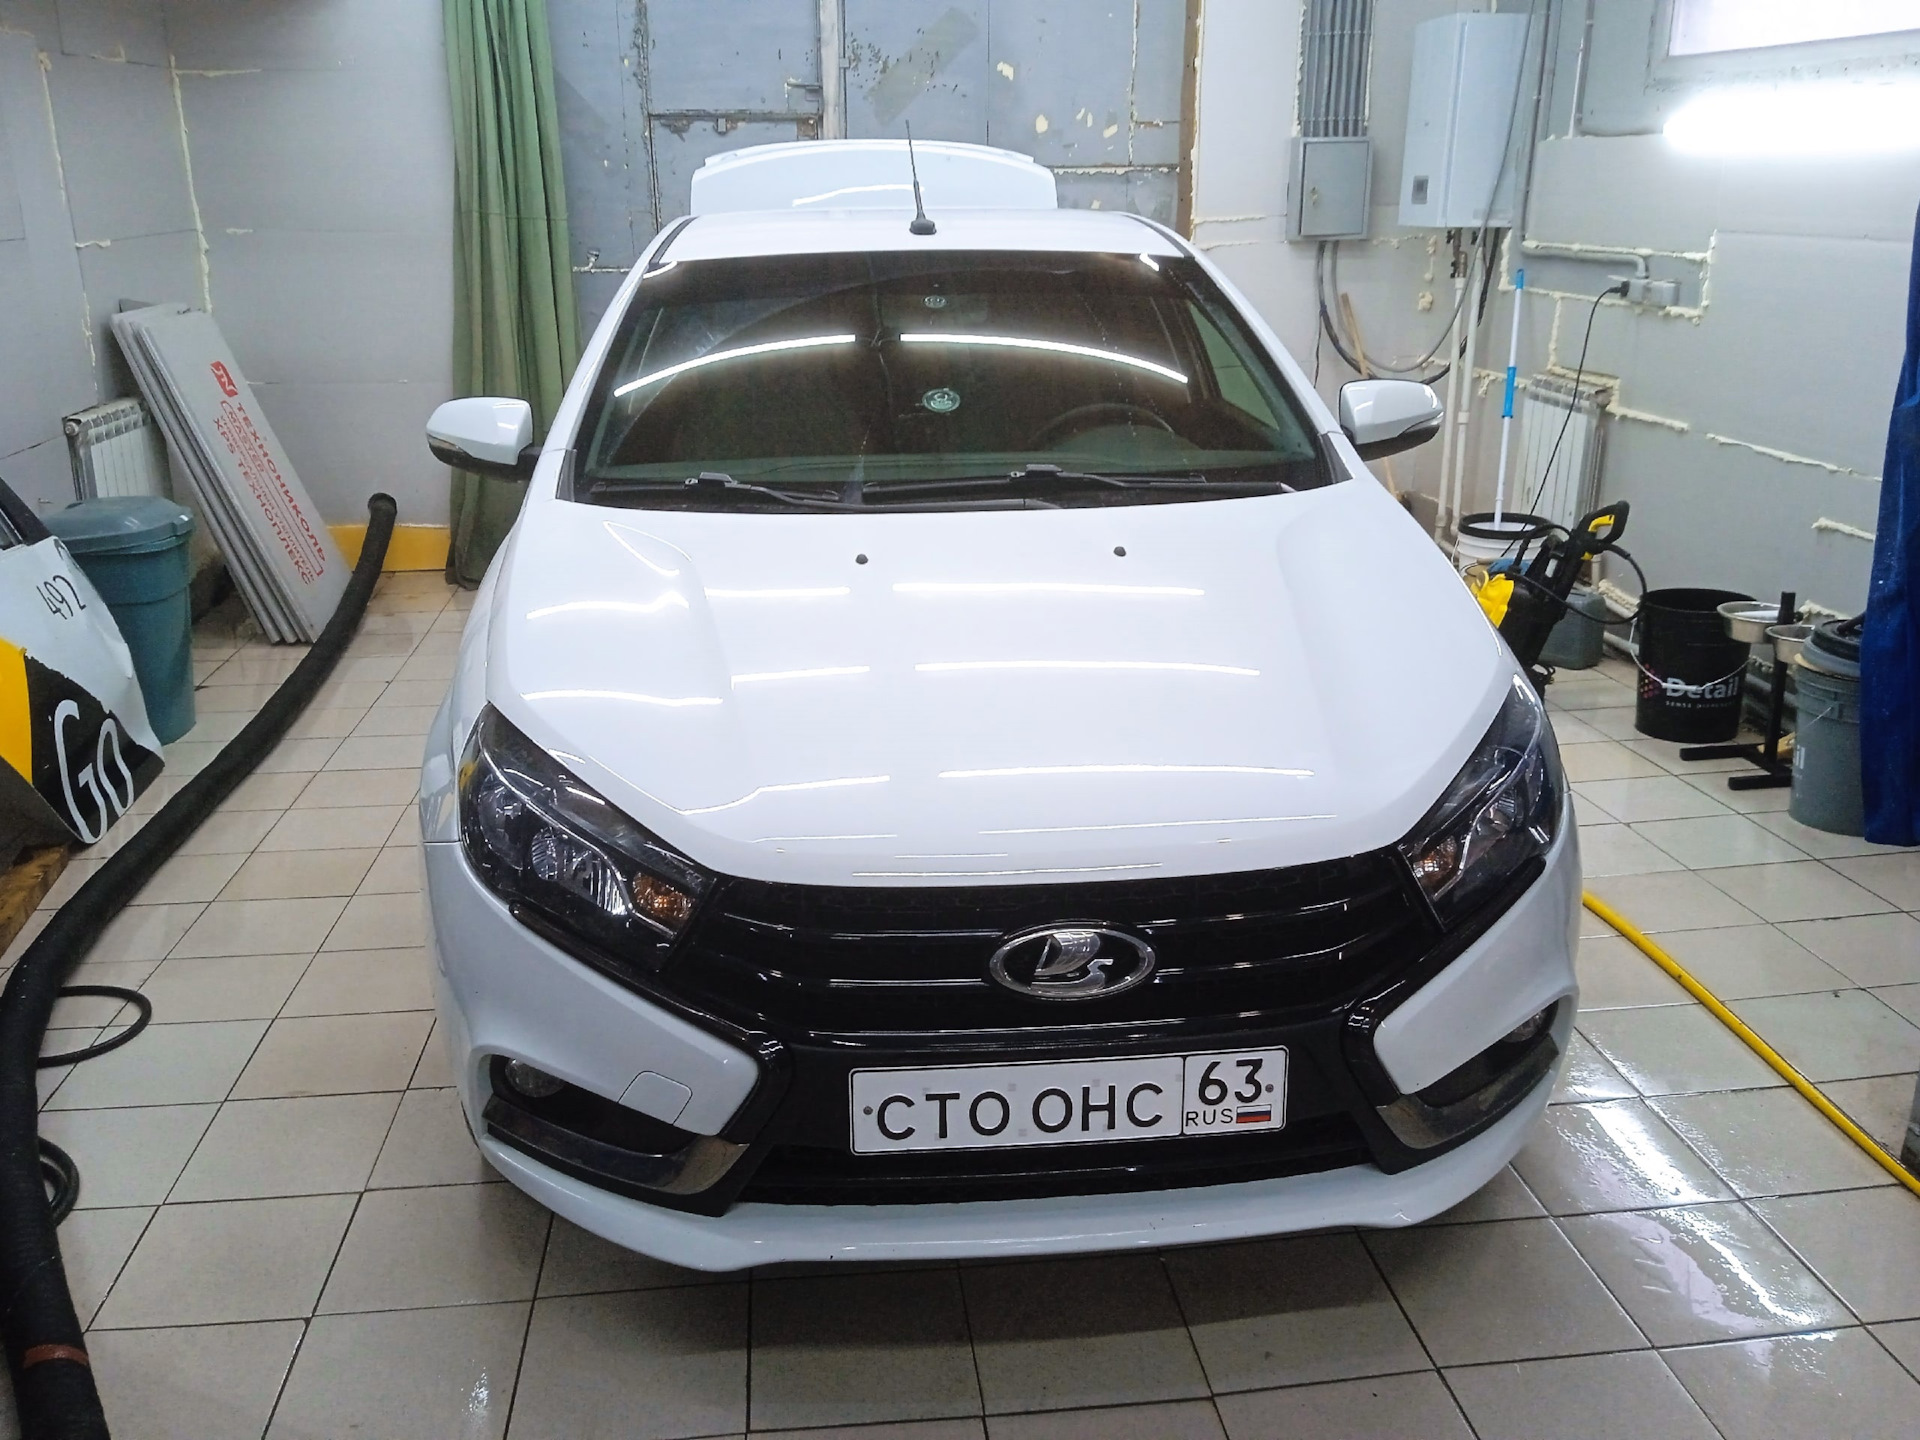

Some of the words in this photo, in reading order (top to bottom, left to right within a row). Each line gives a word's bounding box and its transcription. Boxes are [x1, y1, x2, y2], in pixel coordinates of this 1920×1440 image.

[213, 418, 236, 454] XPS
[238, 459, 311, 585] ТЕХНОПЛЕКС
[237, 402, 325, 561] ТЕХНОНИКОЛЬ
[36, 575, 87, 620] 492
[1666, 676, 1739, 698] Detail
[1198, 1058, 1264, 1106] 63
[1185, 1108, 1234, 1127] RUS
